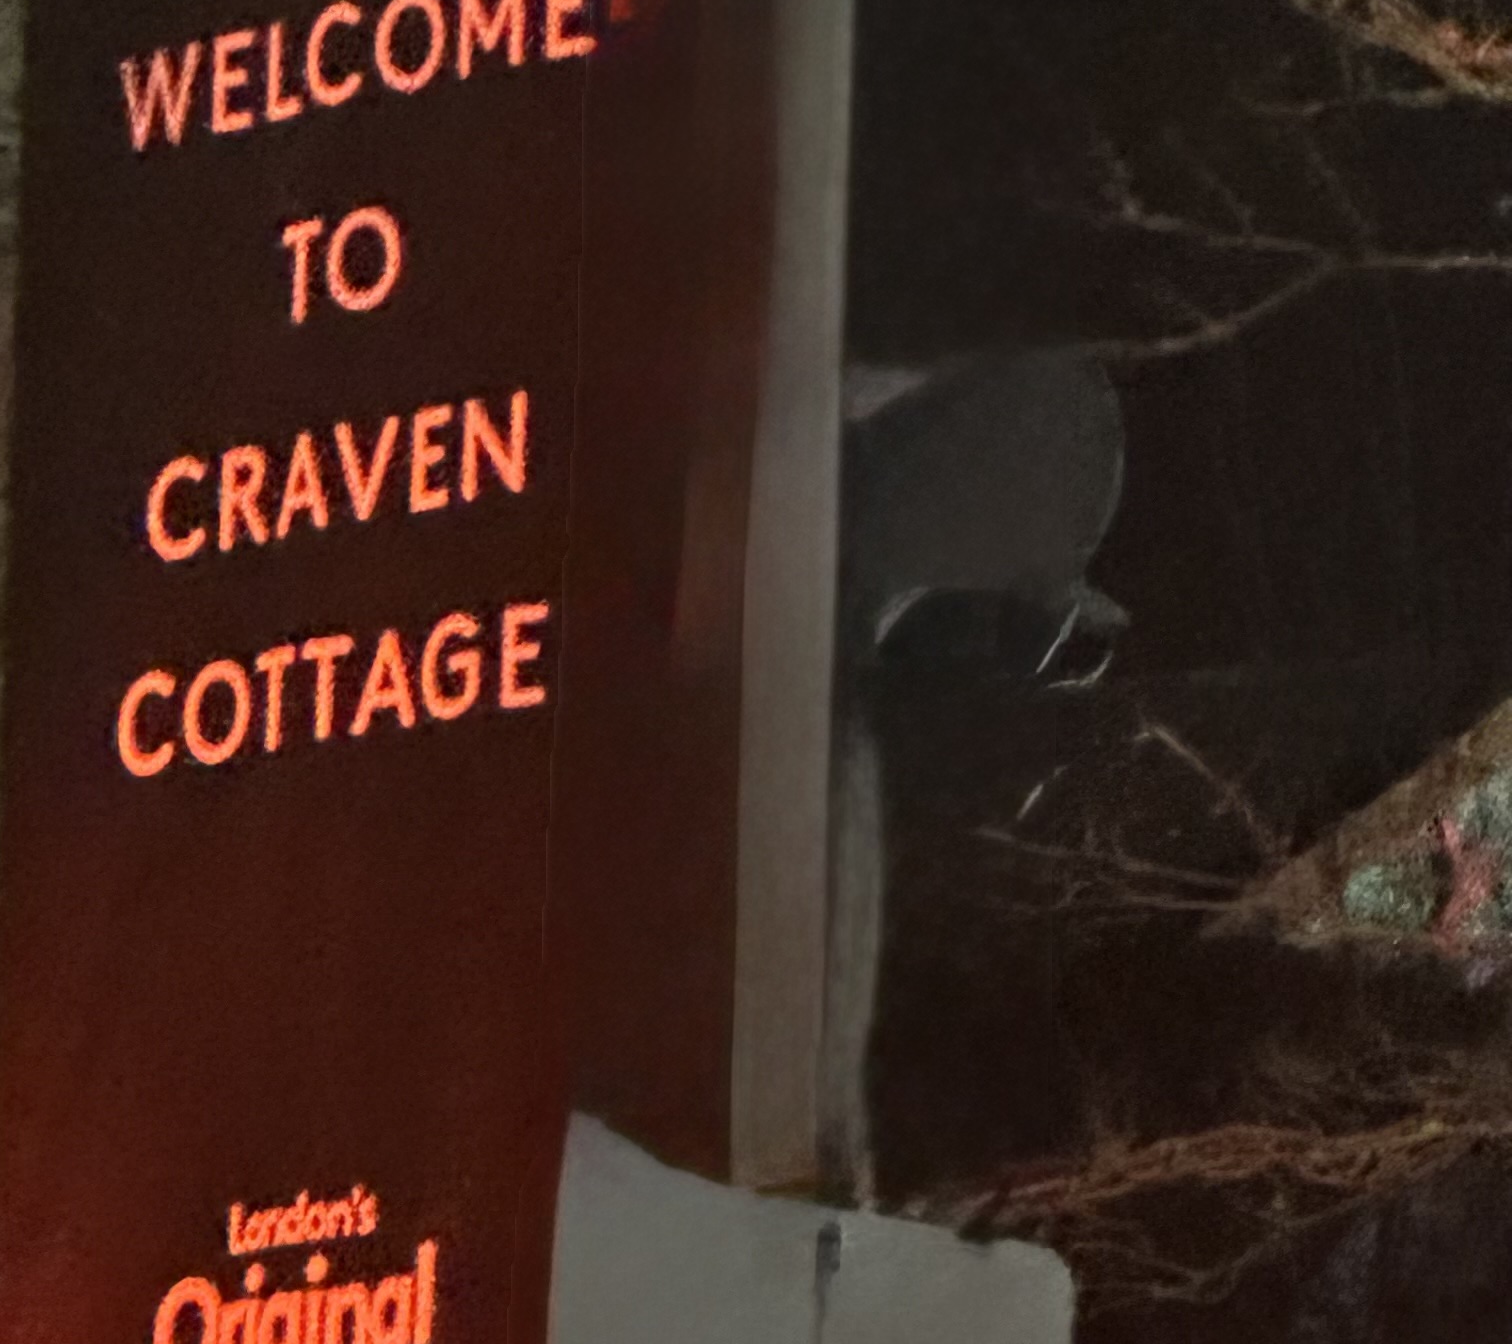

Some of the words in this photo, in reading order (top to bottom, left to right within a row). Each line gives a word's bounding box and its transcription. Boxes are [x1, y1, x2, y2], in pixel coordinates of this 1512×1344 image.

[282, 206, 402, 325] TO
[145, 390, 529, 563] CRAVEN
[116, 601, 550, 778] COTTAGE
[228, 1183, 379, 1256] London's
